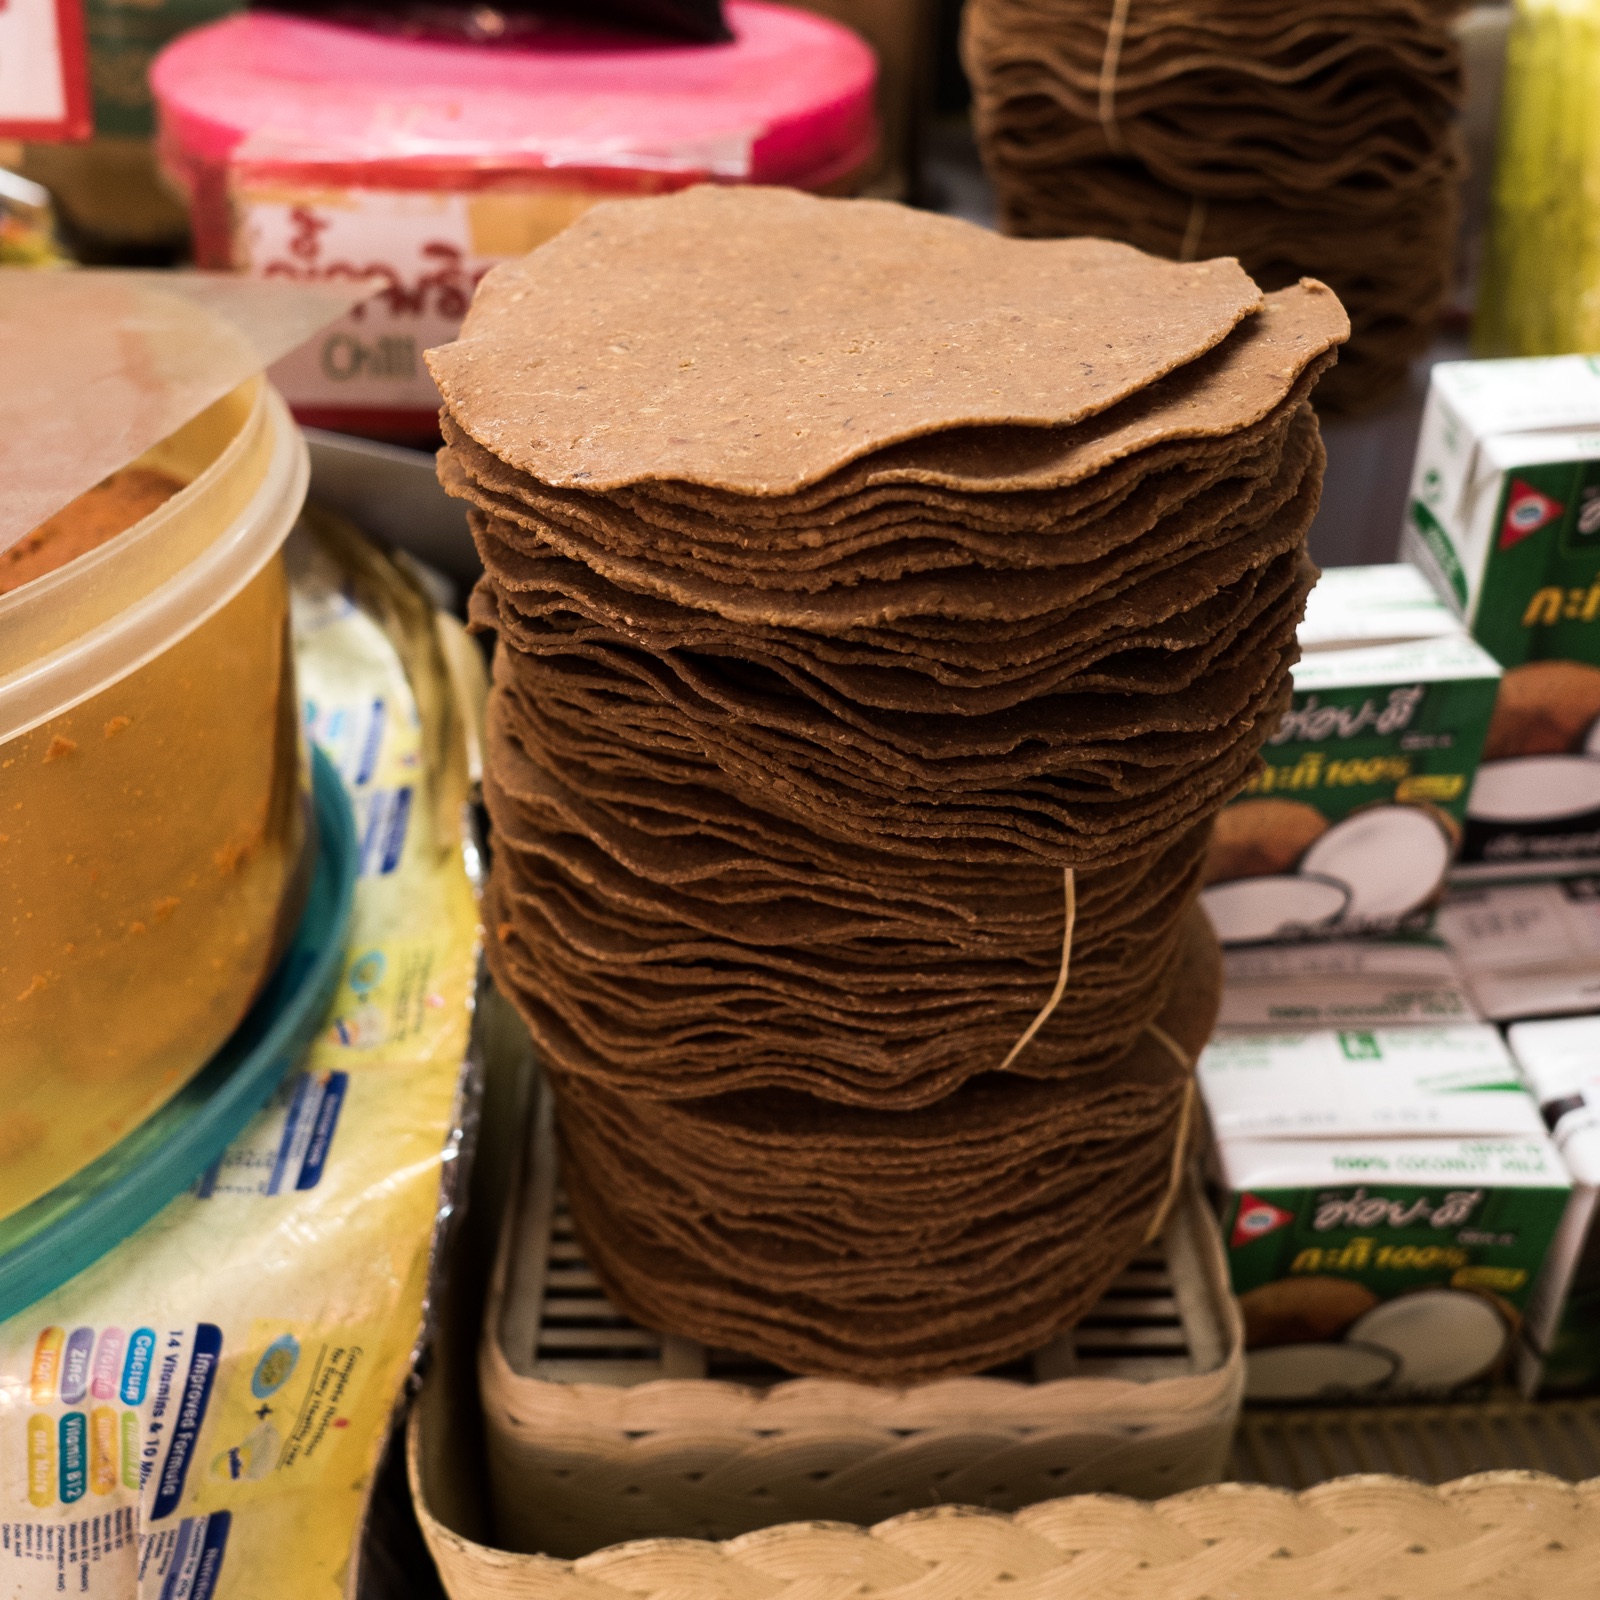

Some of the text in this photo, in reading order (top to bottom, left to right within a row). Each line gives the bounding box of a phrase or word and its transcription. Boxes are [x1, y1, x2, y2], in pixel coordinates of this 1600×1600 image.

[67, 1347, 88, 1384] Zinc
[96, 1338, 120, 1394] Protein
[125, 1334, 153, 1402] Calcium
[167, 1330, 183, 1348] 14
[152, 1353, 180, 1418] Vitamins
[180, 1352, 215, 1430] Improved
[33, 1429, 49, 1494] and More
[65, 1418, 82, 1500] Vitamin B12
[142, 1438, 160, 1457] 10
[160, 1433, 194, 1497] Formula
